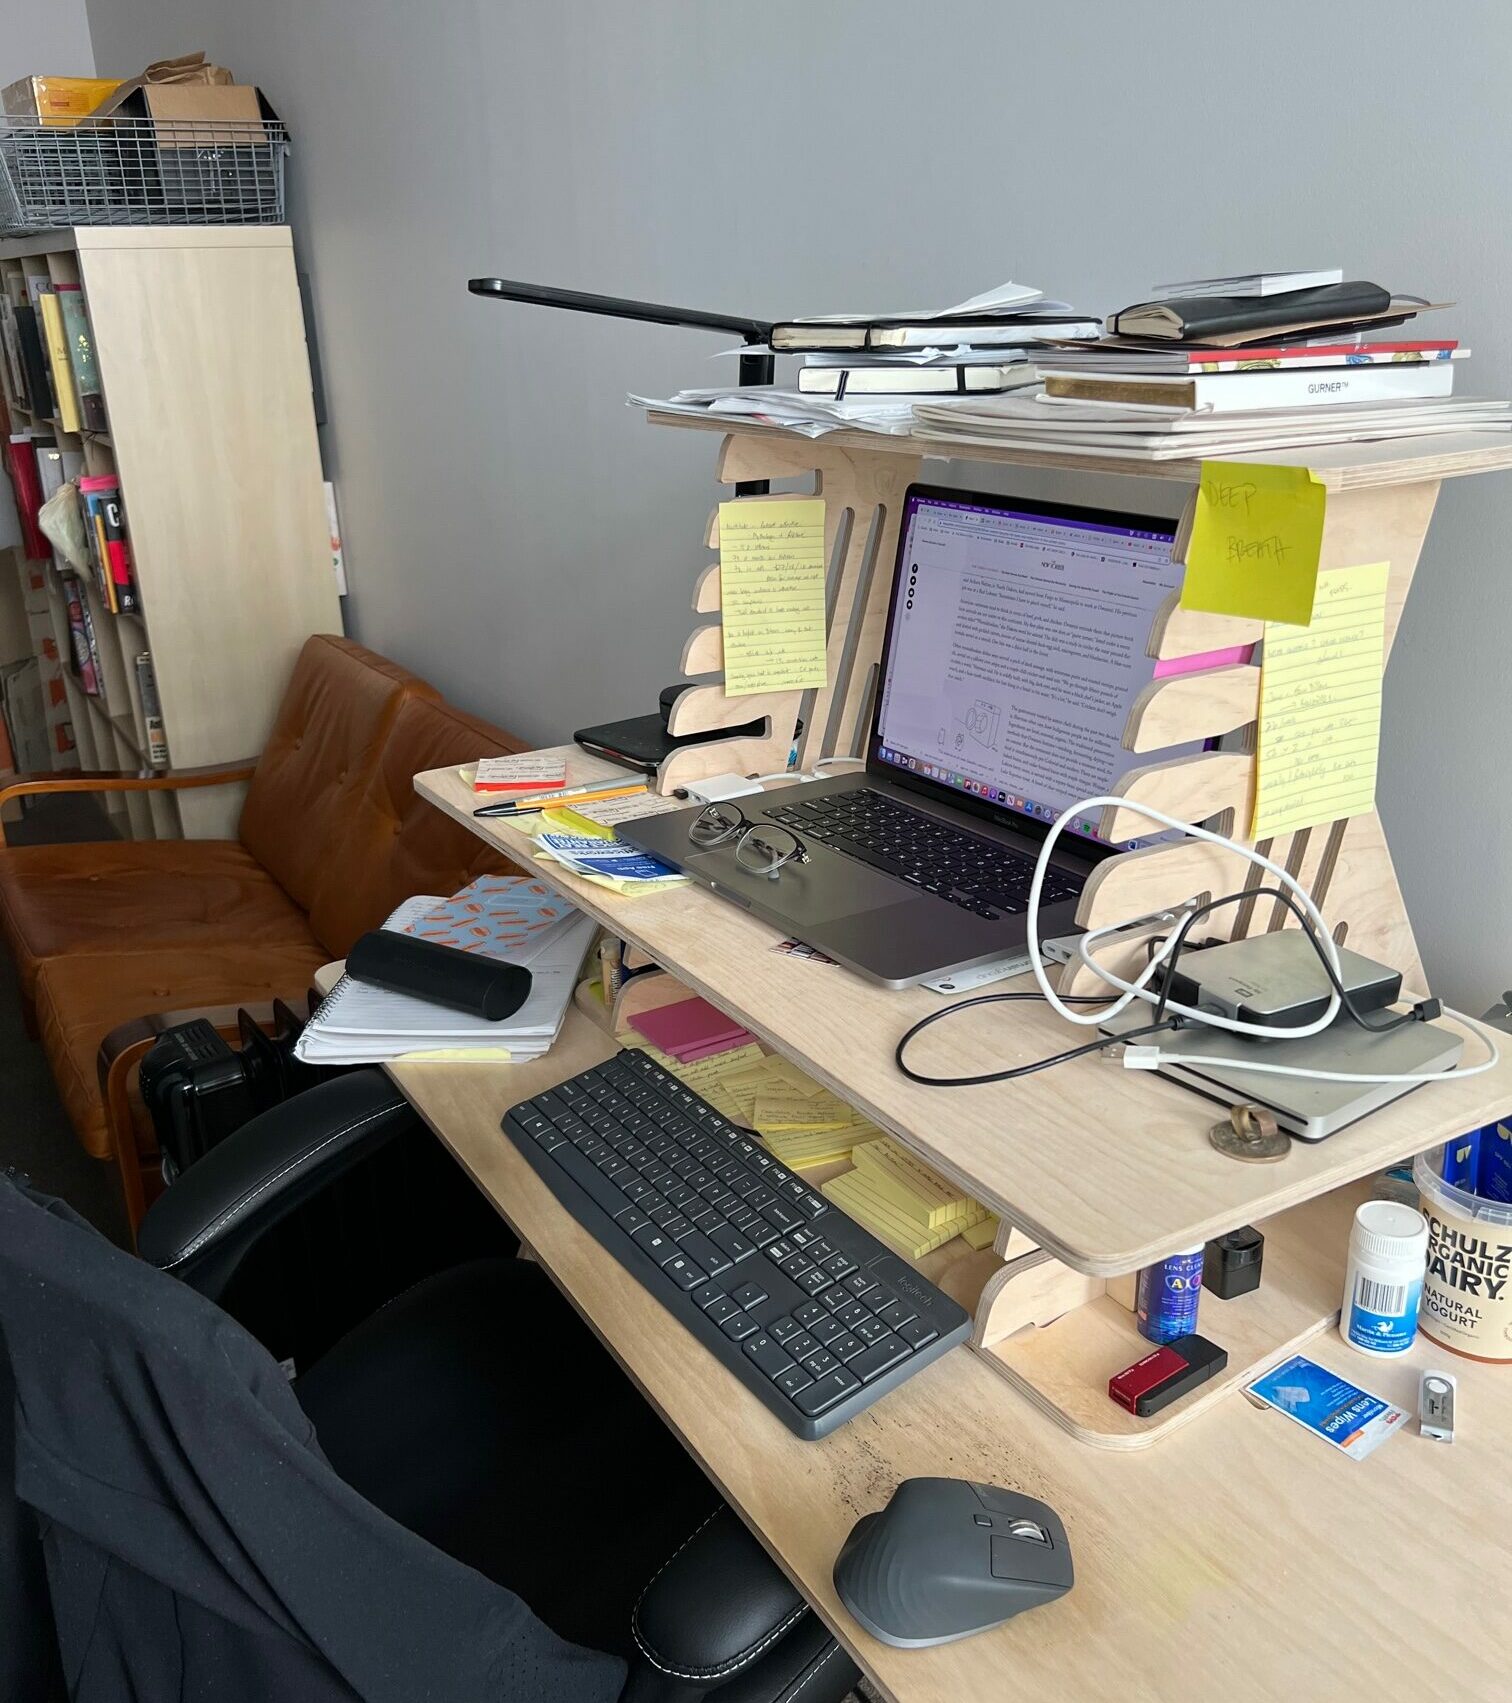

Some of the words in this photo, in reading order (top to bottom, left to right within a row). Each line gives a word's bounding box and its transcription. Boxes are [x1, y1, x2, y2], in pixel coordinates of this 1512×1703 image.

[1206, 480, 1257, 516] DEEP
[1426, 1248, 1504, 1300] AIRY.
[1428, 1234, 1510, 1278] RGANIC
[1424, 1282, 1482, 1319] NATURAL
[1425, 1295, 1478, 1328] YOGURT
[1326, 1410, 1358, 1434] Wipes
[1355, 1396, 1377, 1413] Lens
